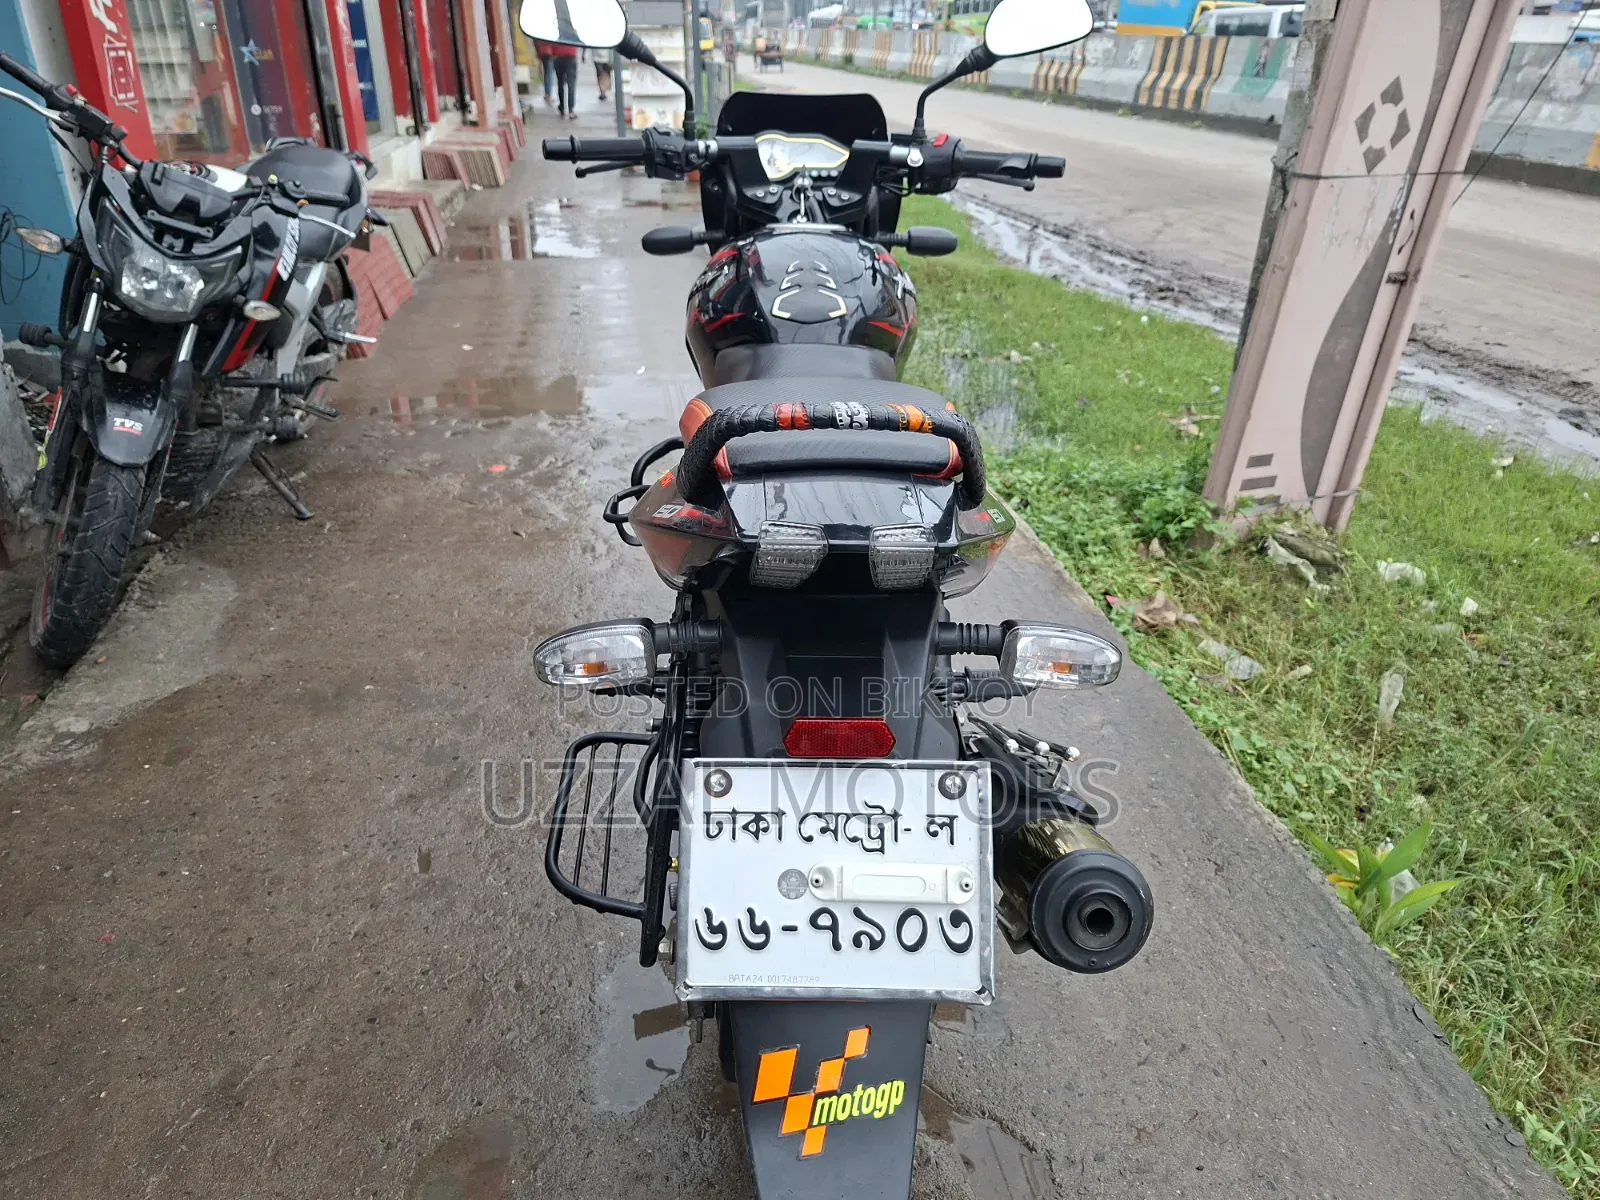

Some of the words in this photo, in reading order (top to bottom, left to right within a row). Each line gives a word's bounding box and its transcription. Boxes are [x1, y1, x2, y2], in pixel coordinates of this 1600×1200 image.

[113, 417, 143, 431] TVS
[703, 806, 787, 843] ঢাকা
[925, 813, 959, 846] ল
[694, 906, 975, 954] ৬৬-৭৯০৩
[728, 974, 763, 984] BRTA24
[812, 1078, 906, 1127] motogp
